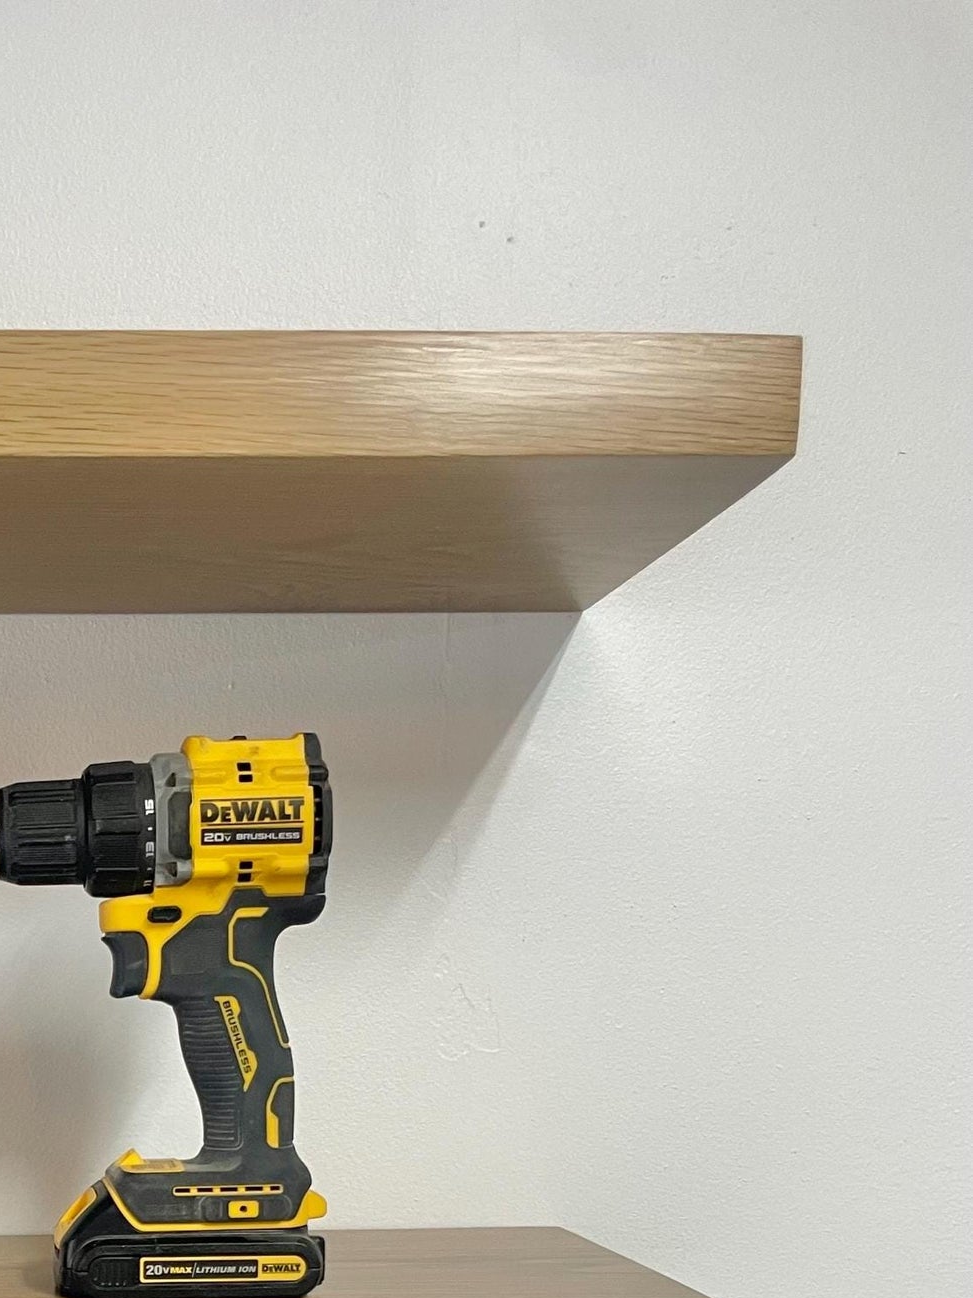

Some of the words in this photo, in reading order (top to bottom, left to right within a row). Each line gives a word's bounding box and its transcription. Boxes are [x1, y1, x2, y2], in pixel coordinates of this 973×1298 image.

[235, 831, 301, 841] BRUSHLESS
[222, 1000, 253, 1074] BRUSHLESS
[238, 1265, 257, 1273] ION
